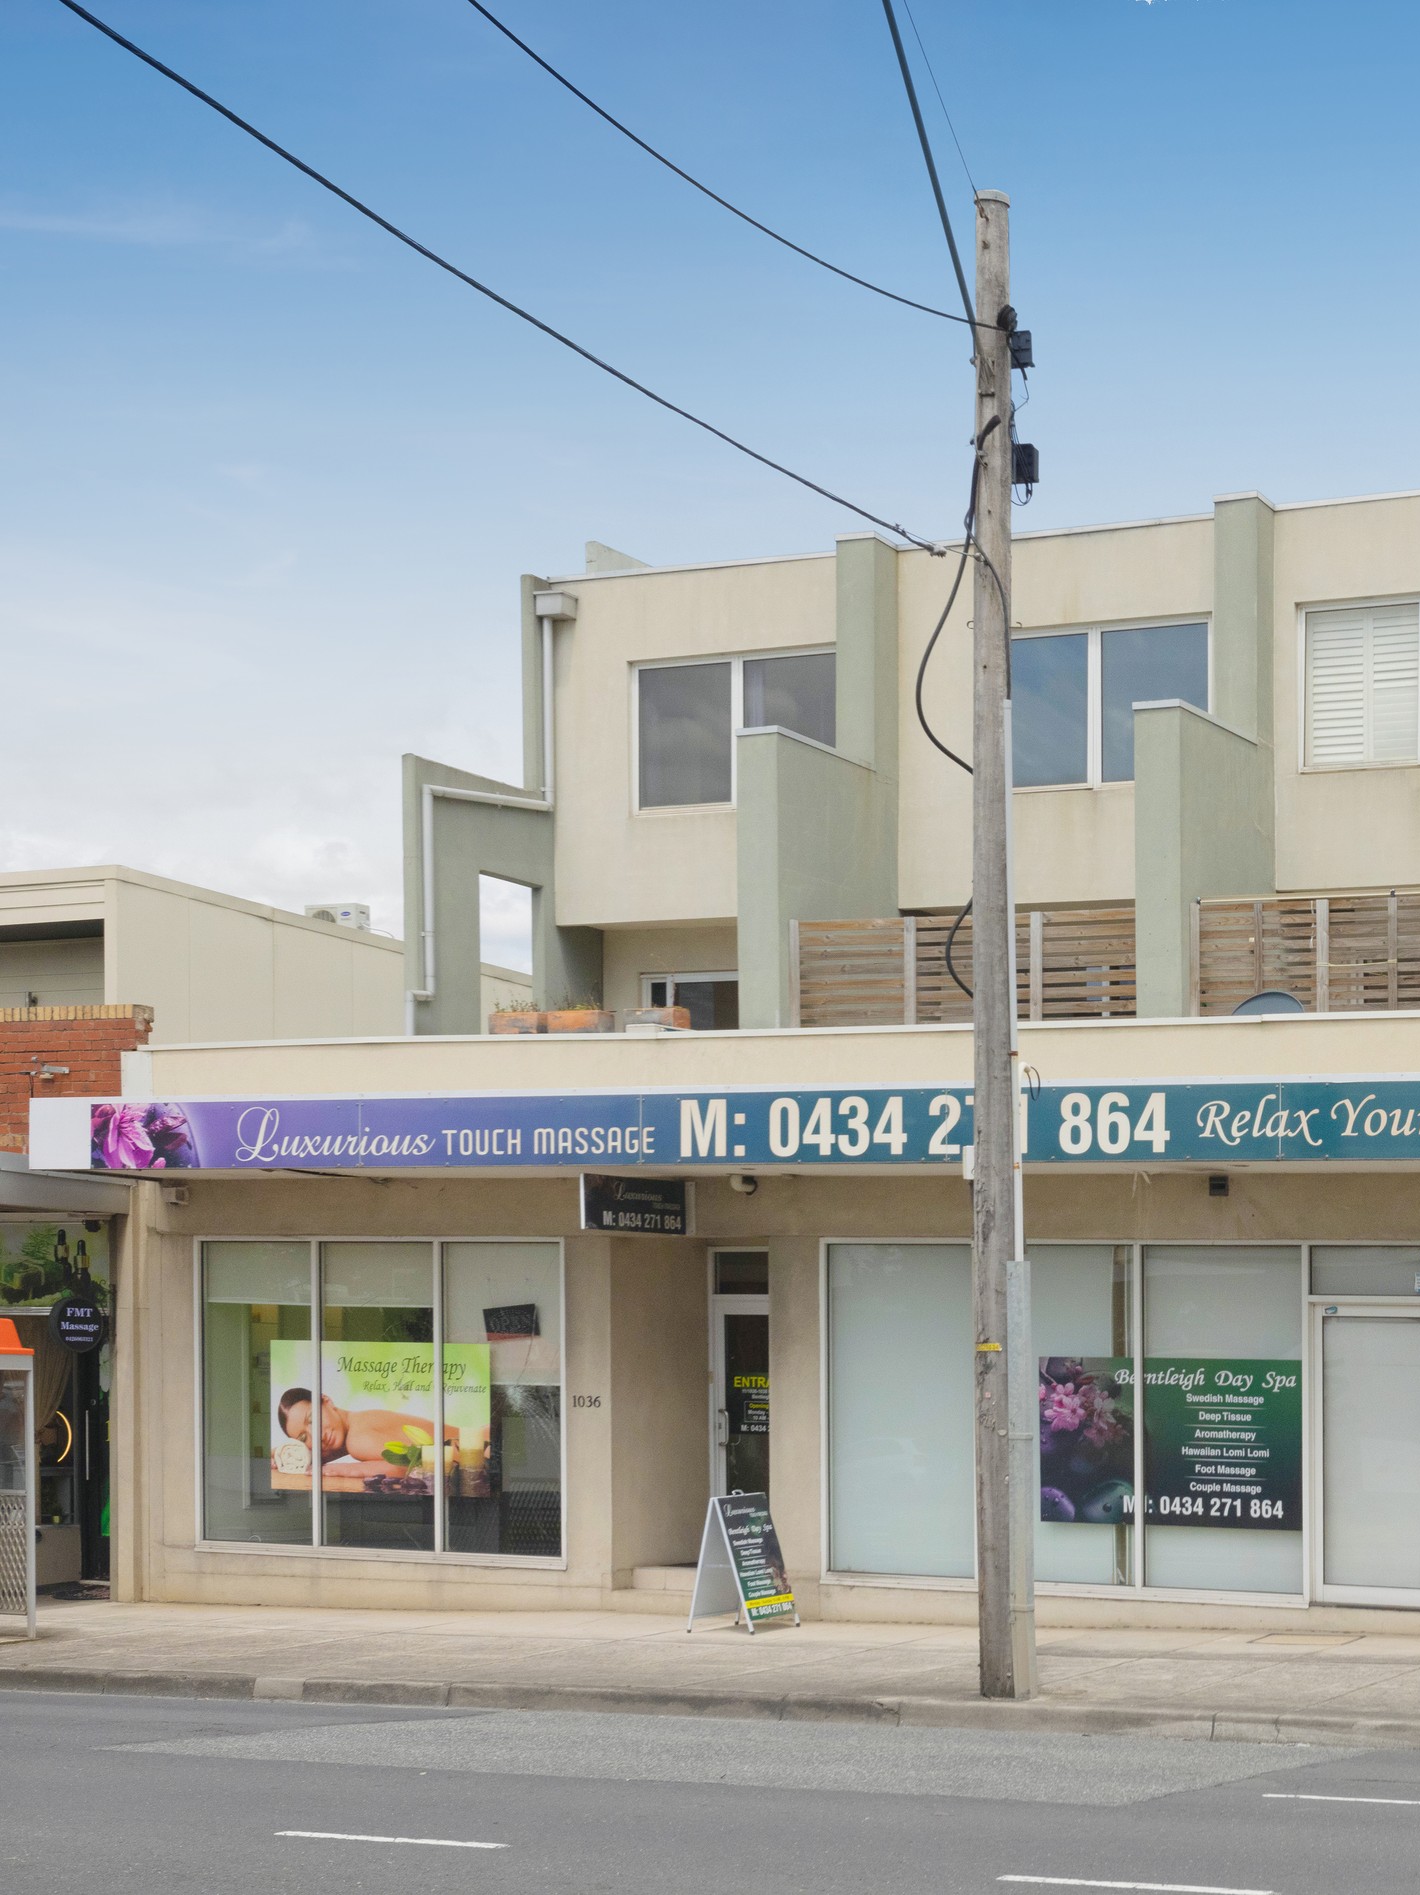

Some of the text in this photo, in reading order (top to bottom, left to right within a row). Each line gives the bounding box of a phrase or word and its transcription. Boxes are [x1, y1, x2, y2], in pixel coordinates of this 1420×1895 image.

[680, 1098, 746, 1157] M:
[768, 1096, 908, 1158] 0434
[1058, 1091, 1171, 1155] 864
[1196, 1093, 1323, 1147] Relax
[235, 1106, 656, 1162] Luxurious TOUCH MASSAGE
[602, 1210, 682, 1230] M: 0434 271 864
[66, 1307, 93, 1317] FMT
[60, 1321, 99, 1332] Massage
[337, 1355, 467, 1380] Massage Therapy
[1214, 1369, 1255, 1392] Day
[1261, 1371, 1297, 1393] Spa
[415, 1381, 431, 1392] and
[442, 1382, 487, 1396] Rejuvenate
[572, 1394, 602, 1408] 1036
[1186, 1393, 1265, 1406] Swedish Massage
[1198, 1411, 1252, 1423] Deep Tissue
[1194, 1428, 1257, 1442] Aromatherapy
[1181, 1446, 1270, 1458] Hawaiian Lomi Lomi
[1195, 1464, 1257, 1477] Foot Massage
[1189, 1481, 1262, 1495] Couple Massage
[1160, 1495, 1205, 1516] 0434
[1209, 1497, 1242, 1517] 271
[1249, 1498, 1284, 1519] 864
